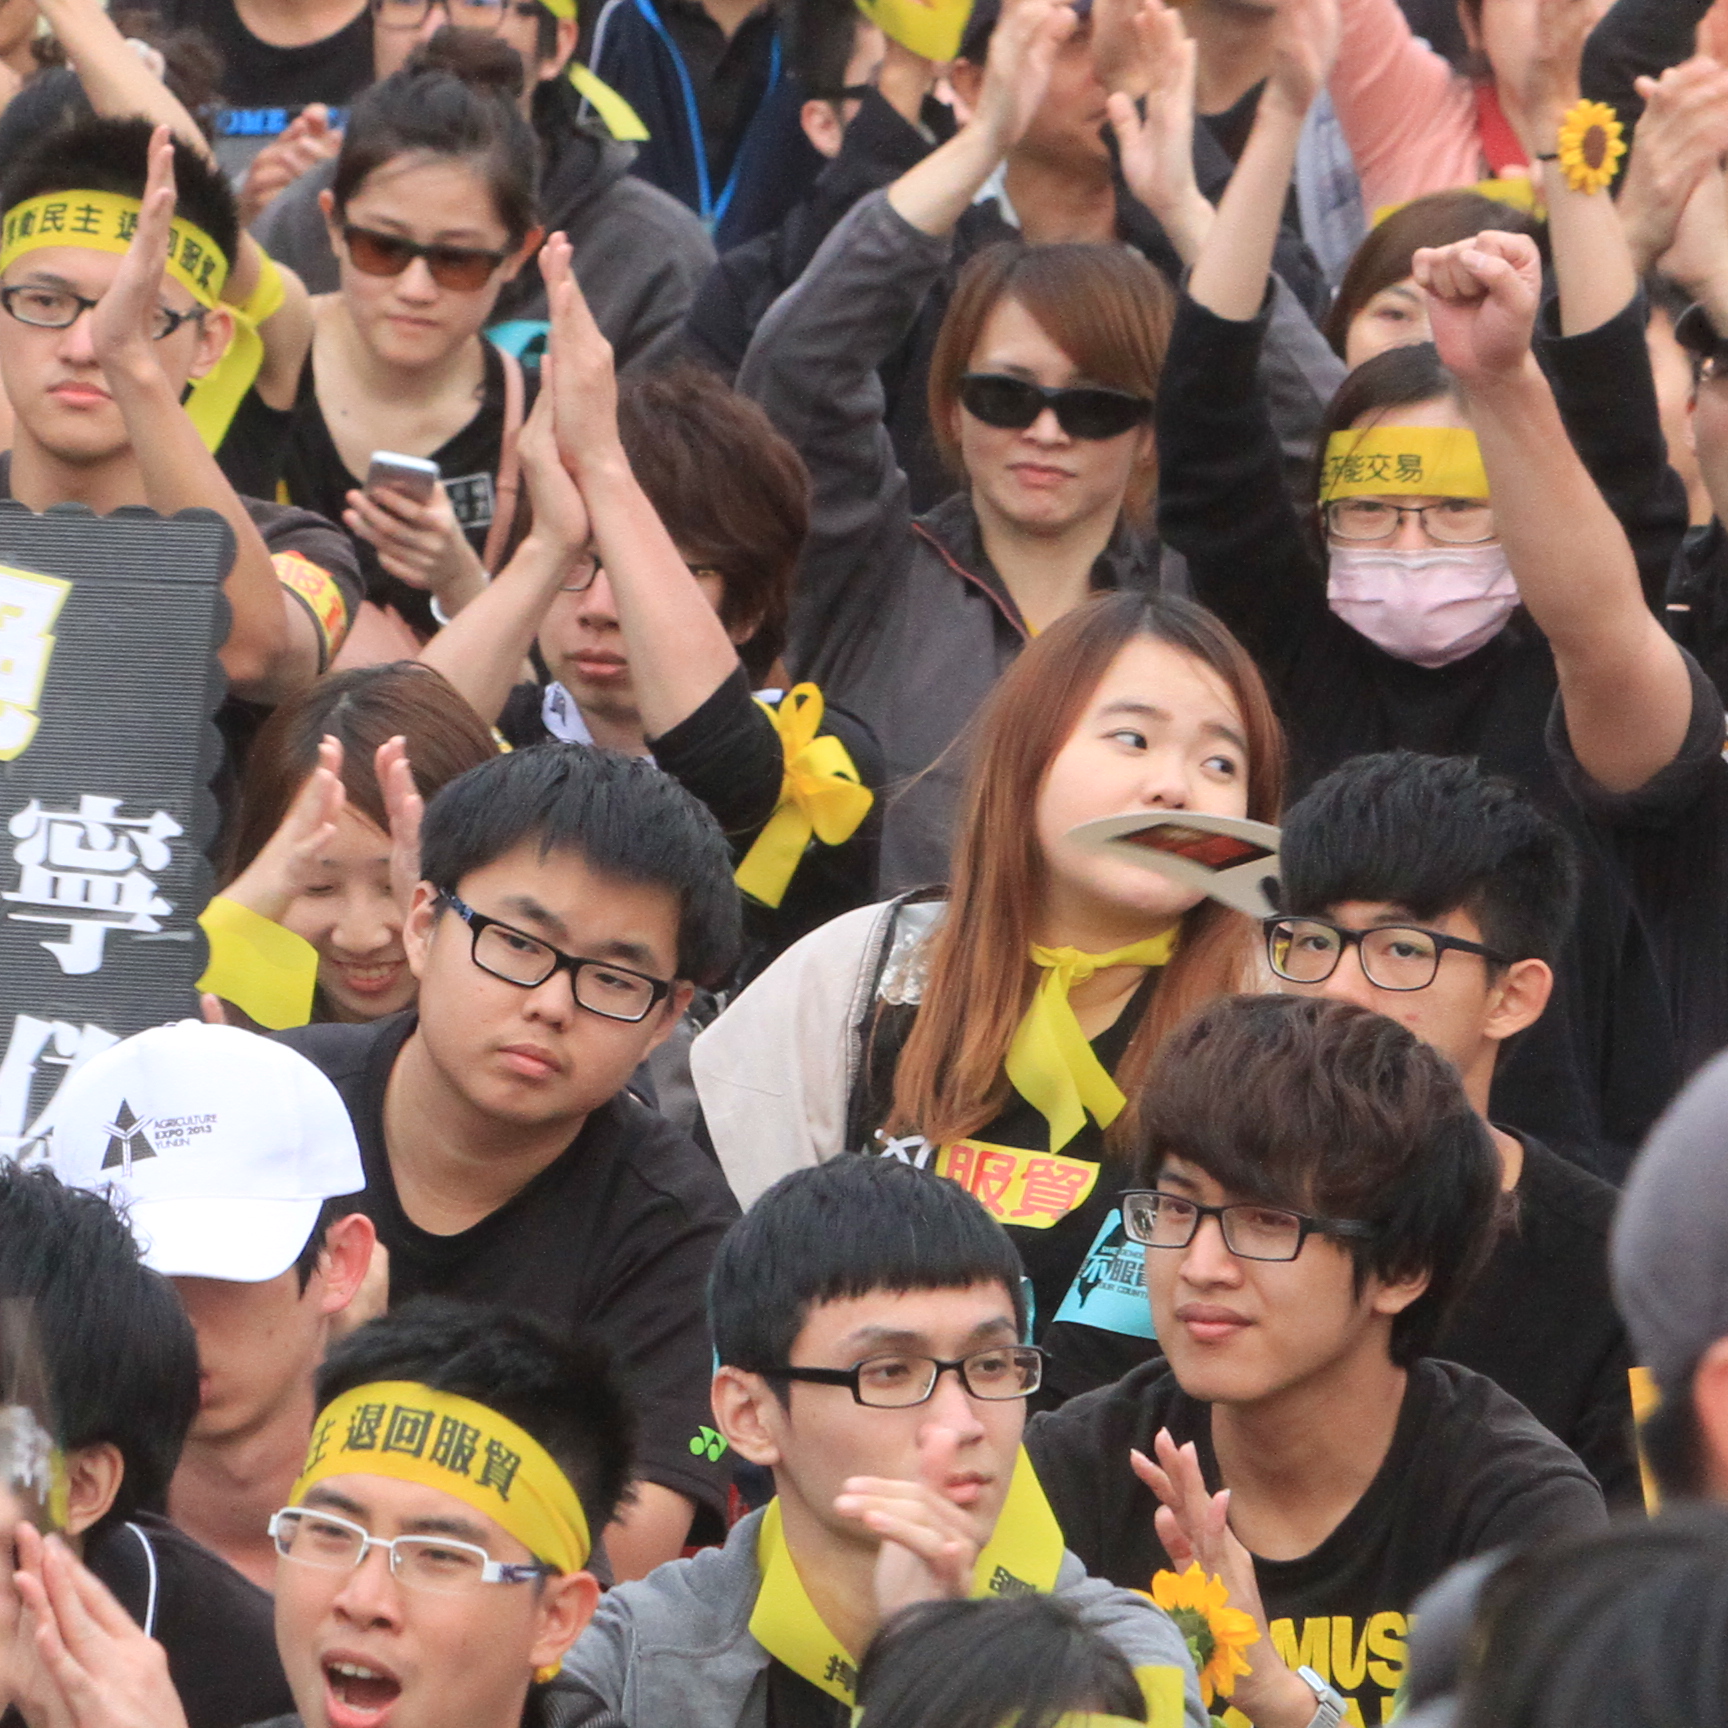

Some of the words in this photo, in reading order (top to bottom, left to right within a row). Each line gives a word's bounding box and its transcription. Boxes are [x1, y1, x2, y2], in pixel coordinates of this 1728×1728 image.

[1321, 453, 1425, 487] 不能交易
[153, 1113, 217, 1130] AGRICULTURE
[154, 1128, 184, 1140] EXPO
[187, 1124, 212, 1135] 2013
[946, 1143, 1091, 1221] 服貿
[339, 1402, 522, 1503] 退回服貿
[1270, 1610, 1418, 1690] MUS
